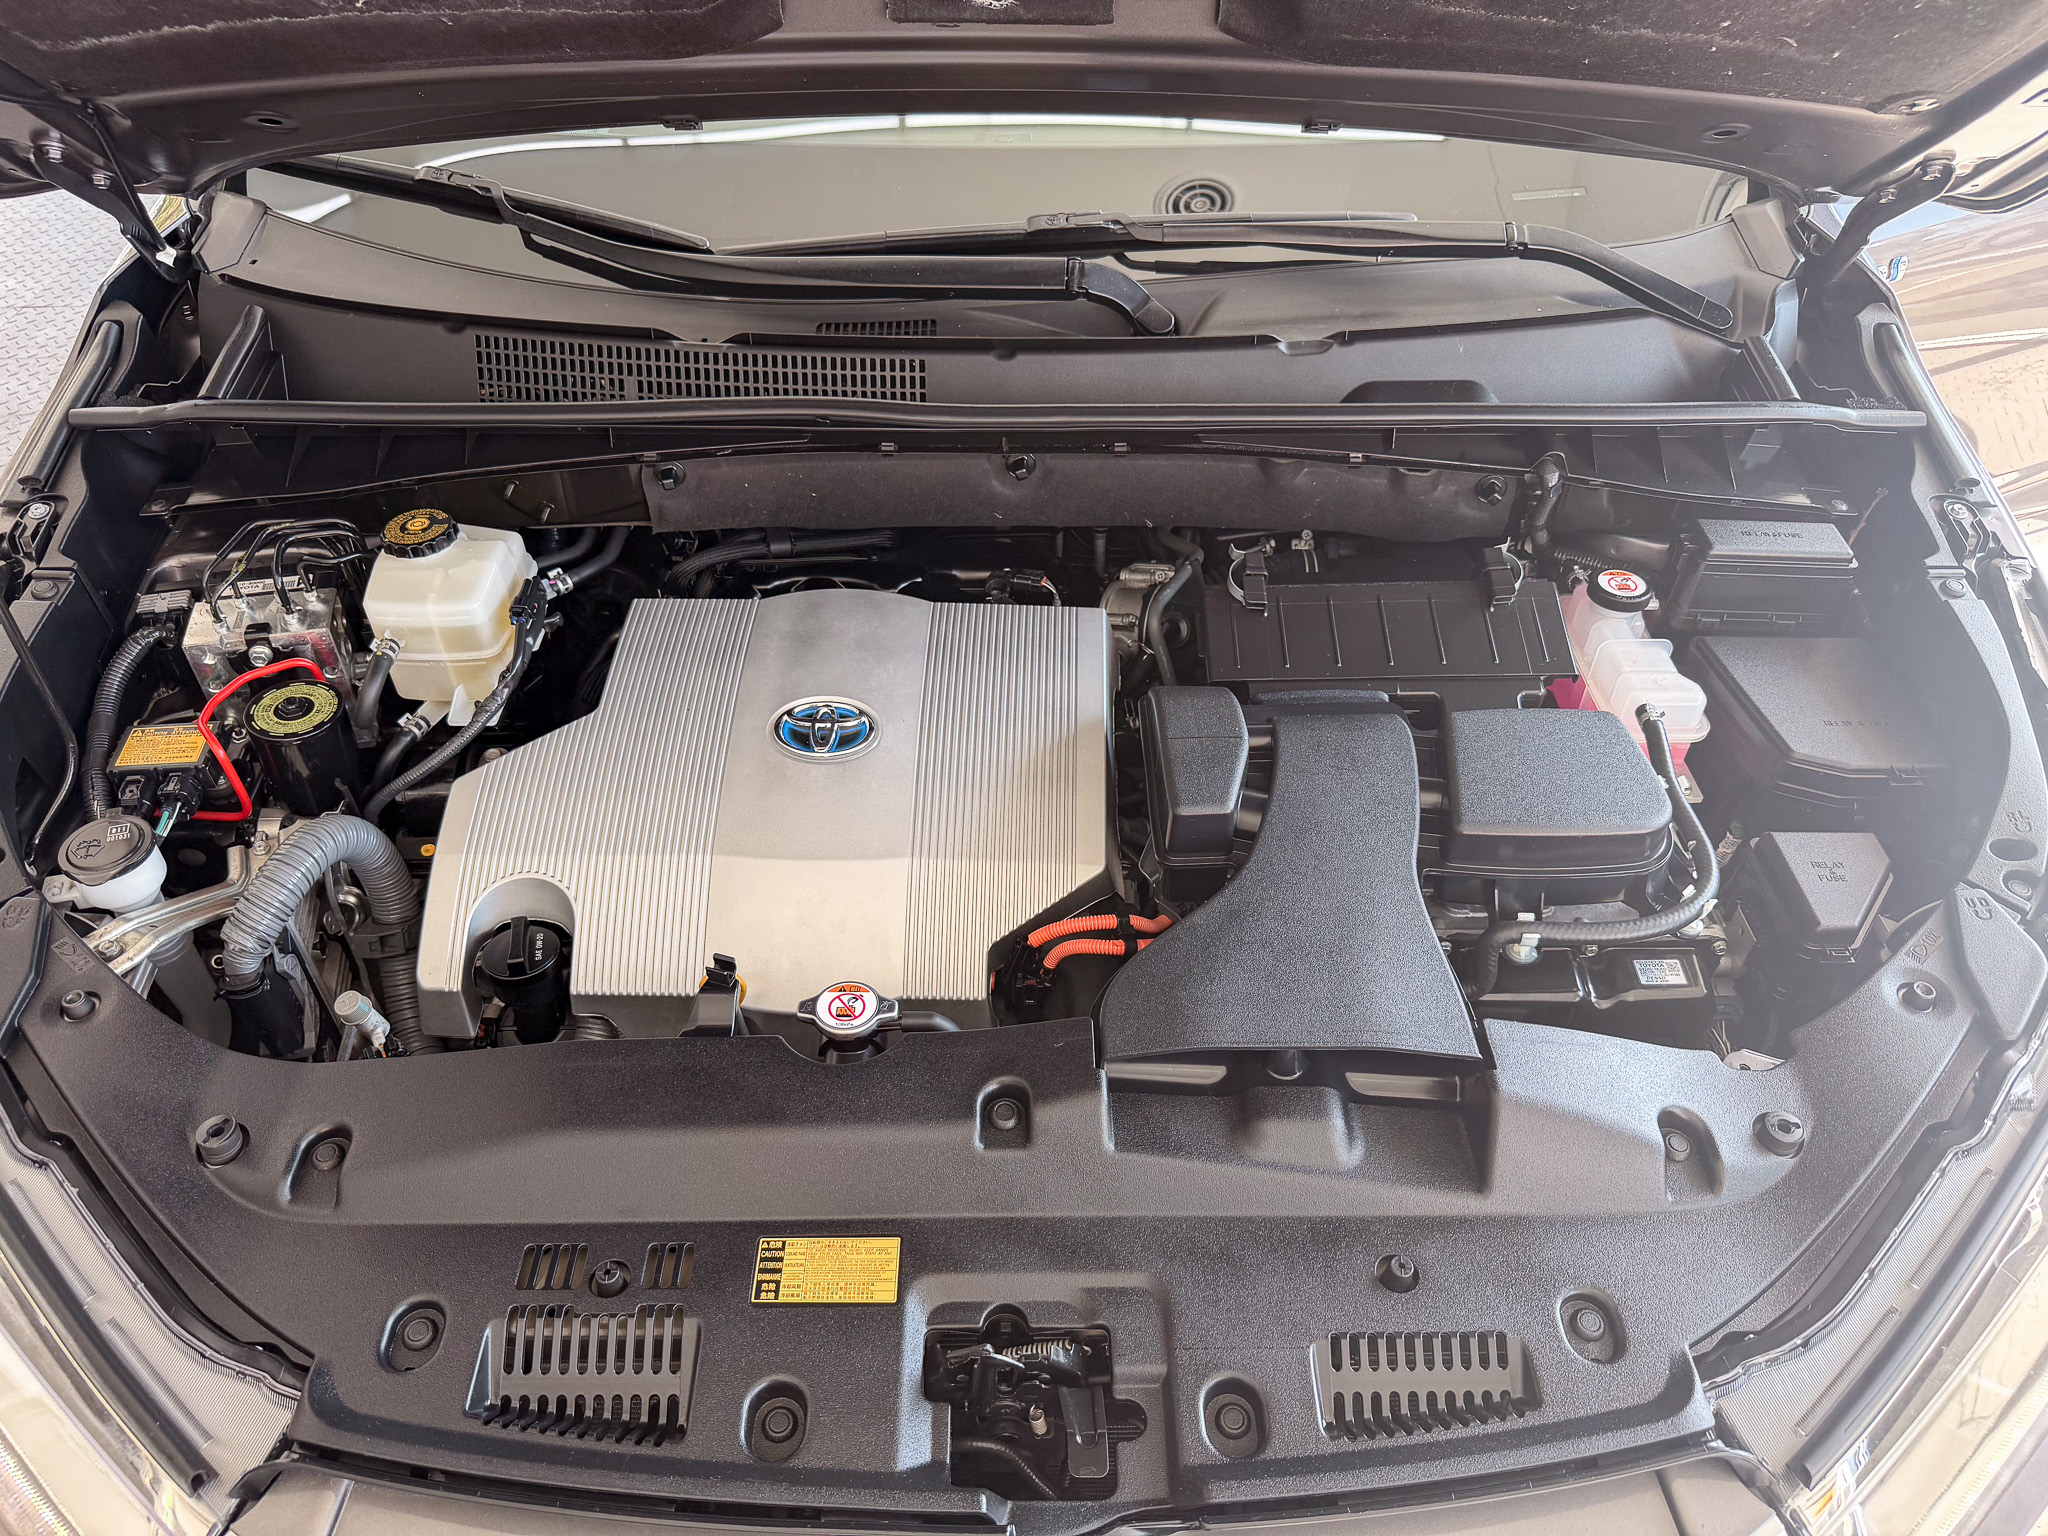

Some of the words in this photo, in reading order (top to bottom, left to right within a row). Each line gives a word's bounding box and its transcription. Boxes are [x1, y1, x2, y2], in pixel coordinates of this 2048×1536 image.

[1810, 861, 1845, 869] RELAY
[1817, 874, 1849, 882] FUSE
[535, 932, 544, 949] 0W-20
[534, 949, 543, 961] SAE
[761, 1250, 785, 1258] CAUTION
[759, 1261, 784, 1269] ATTENTION
